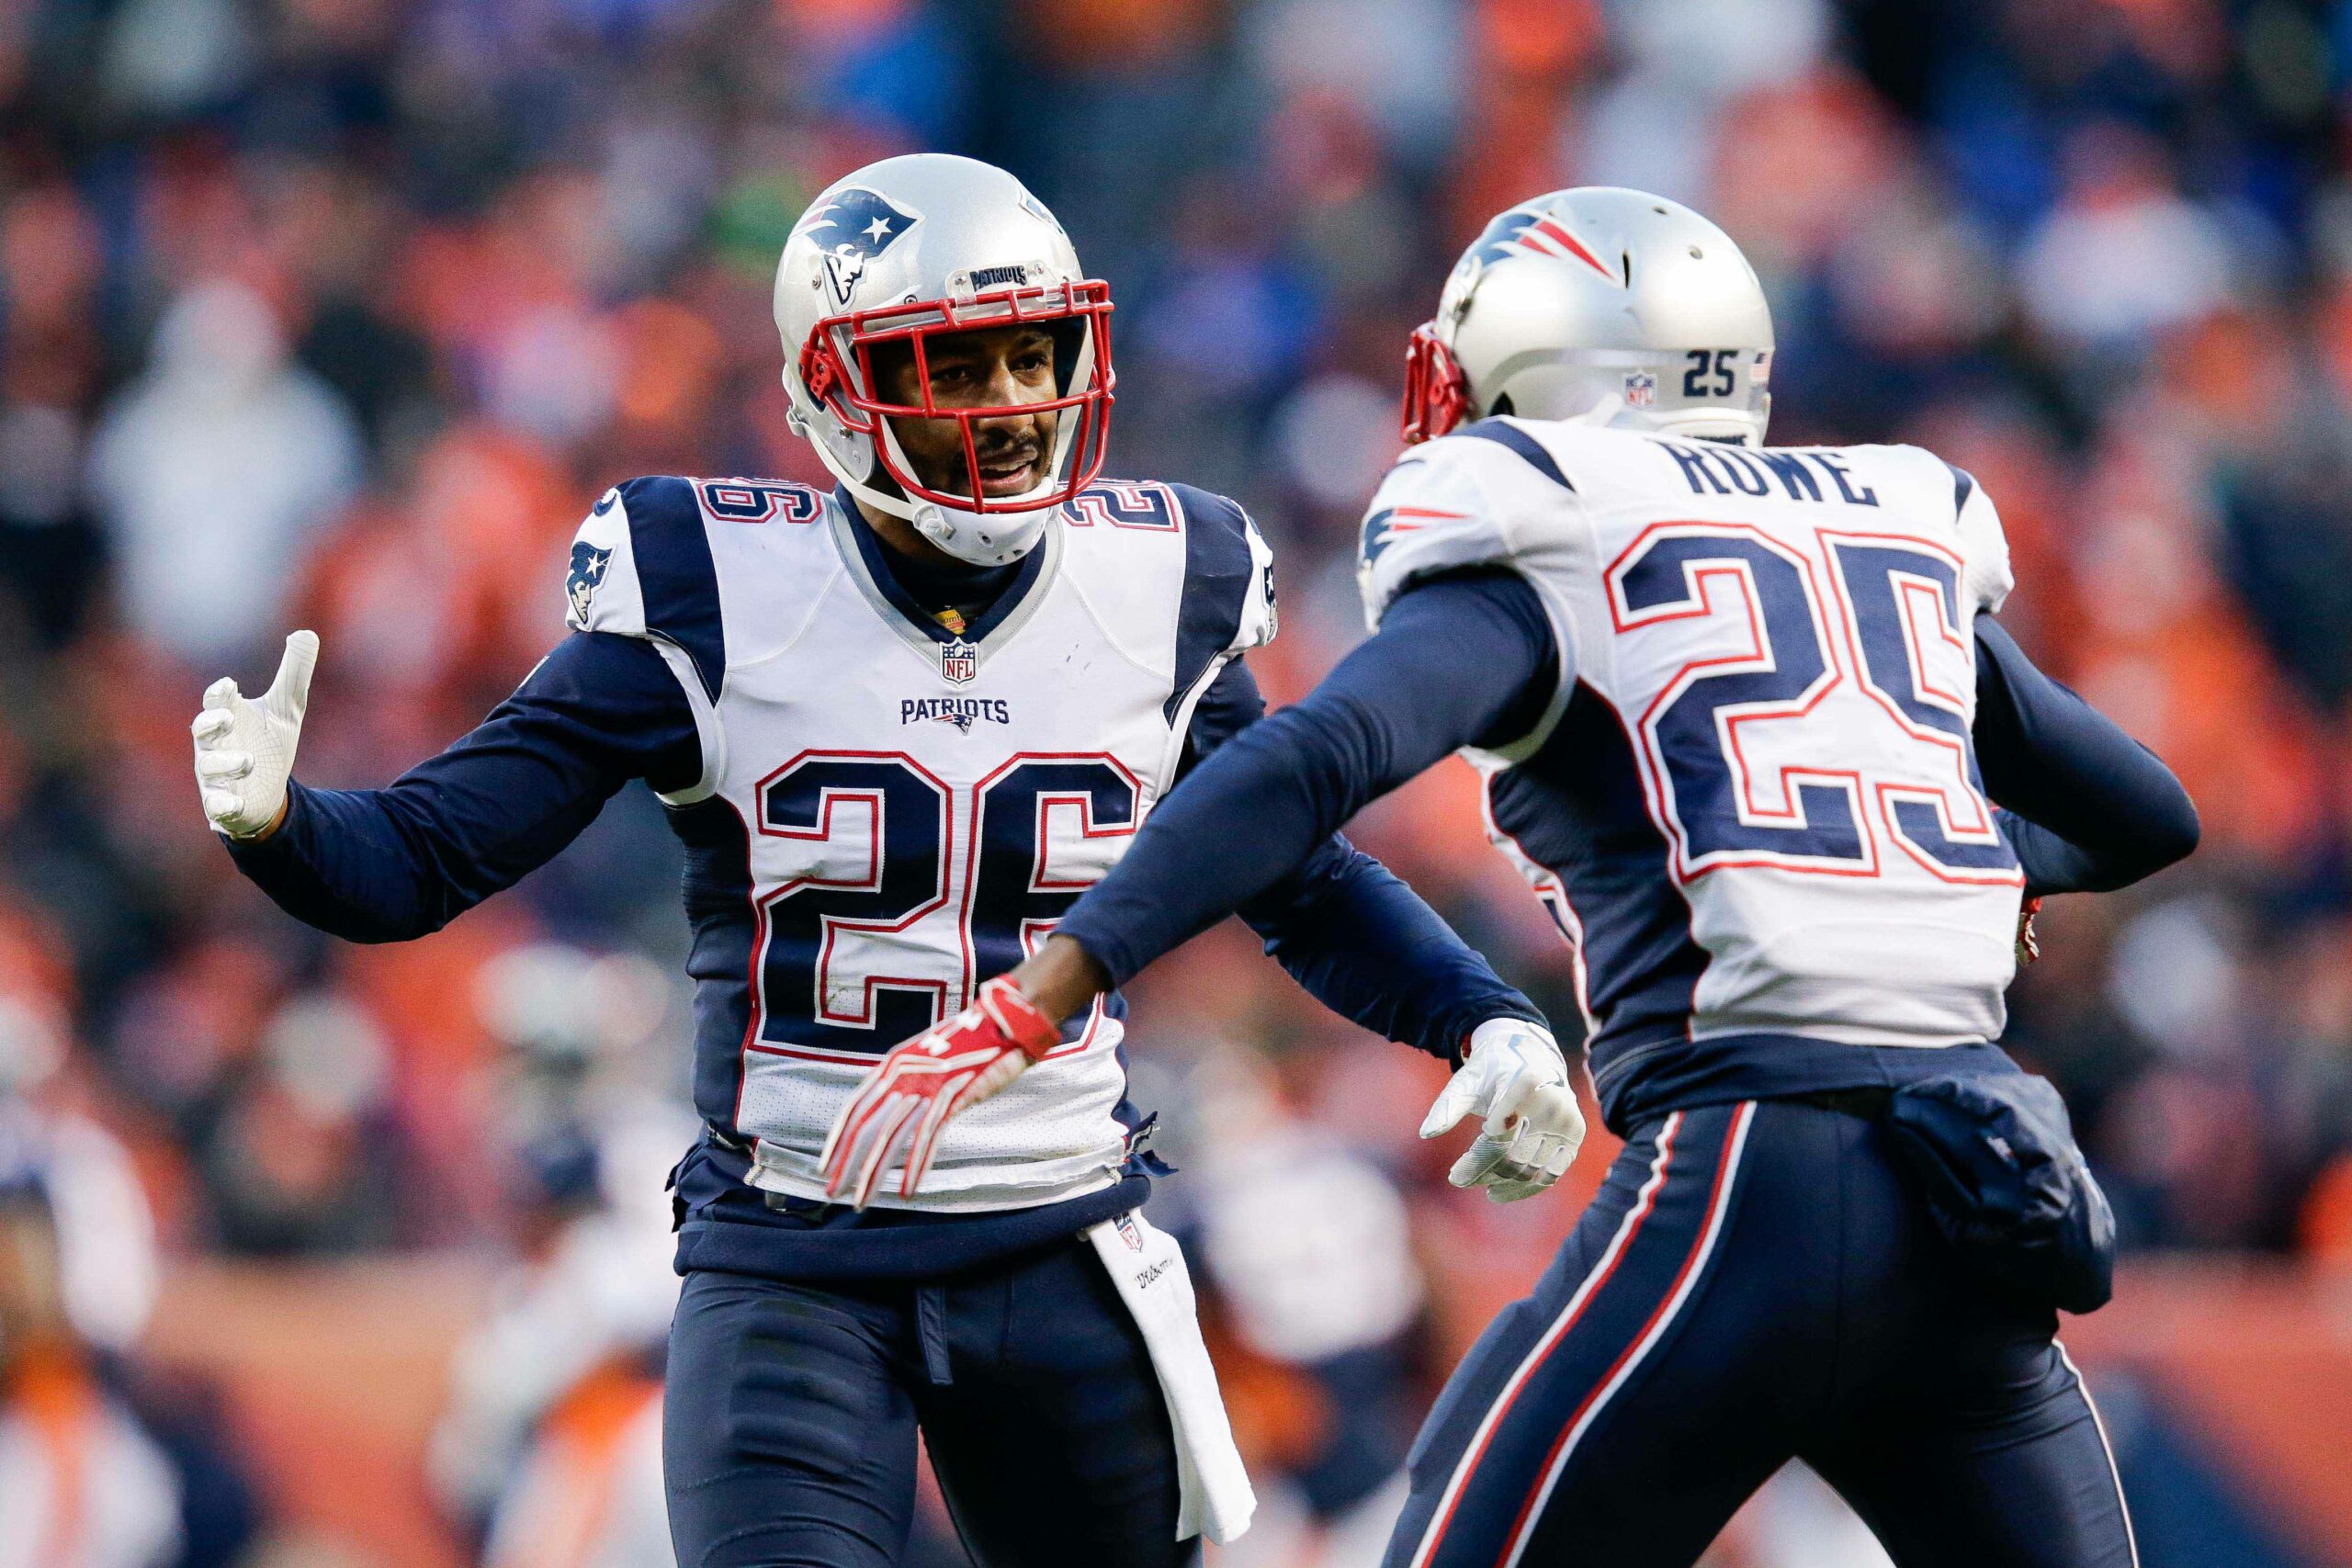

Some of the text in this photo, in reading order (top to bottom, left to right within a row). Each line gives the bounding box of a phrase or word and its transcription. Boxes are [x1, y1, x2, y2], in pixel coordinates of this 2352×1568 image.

[969, 265, 1028, 292] PATRIOTS
[1683, 349, 1739, 397] 25
[1654, 441, 1880, 507] ROWE
[945, 660, 973, 680] NFL
[901, 699, 1010, 725] PATRIOTS
[1603, 520, 2024, 888] 25
[747, 749, 1142, 1066] 26
[1119, 1224, 1142, 1250] NFL
